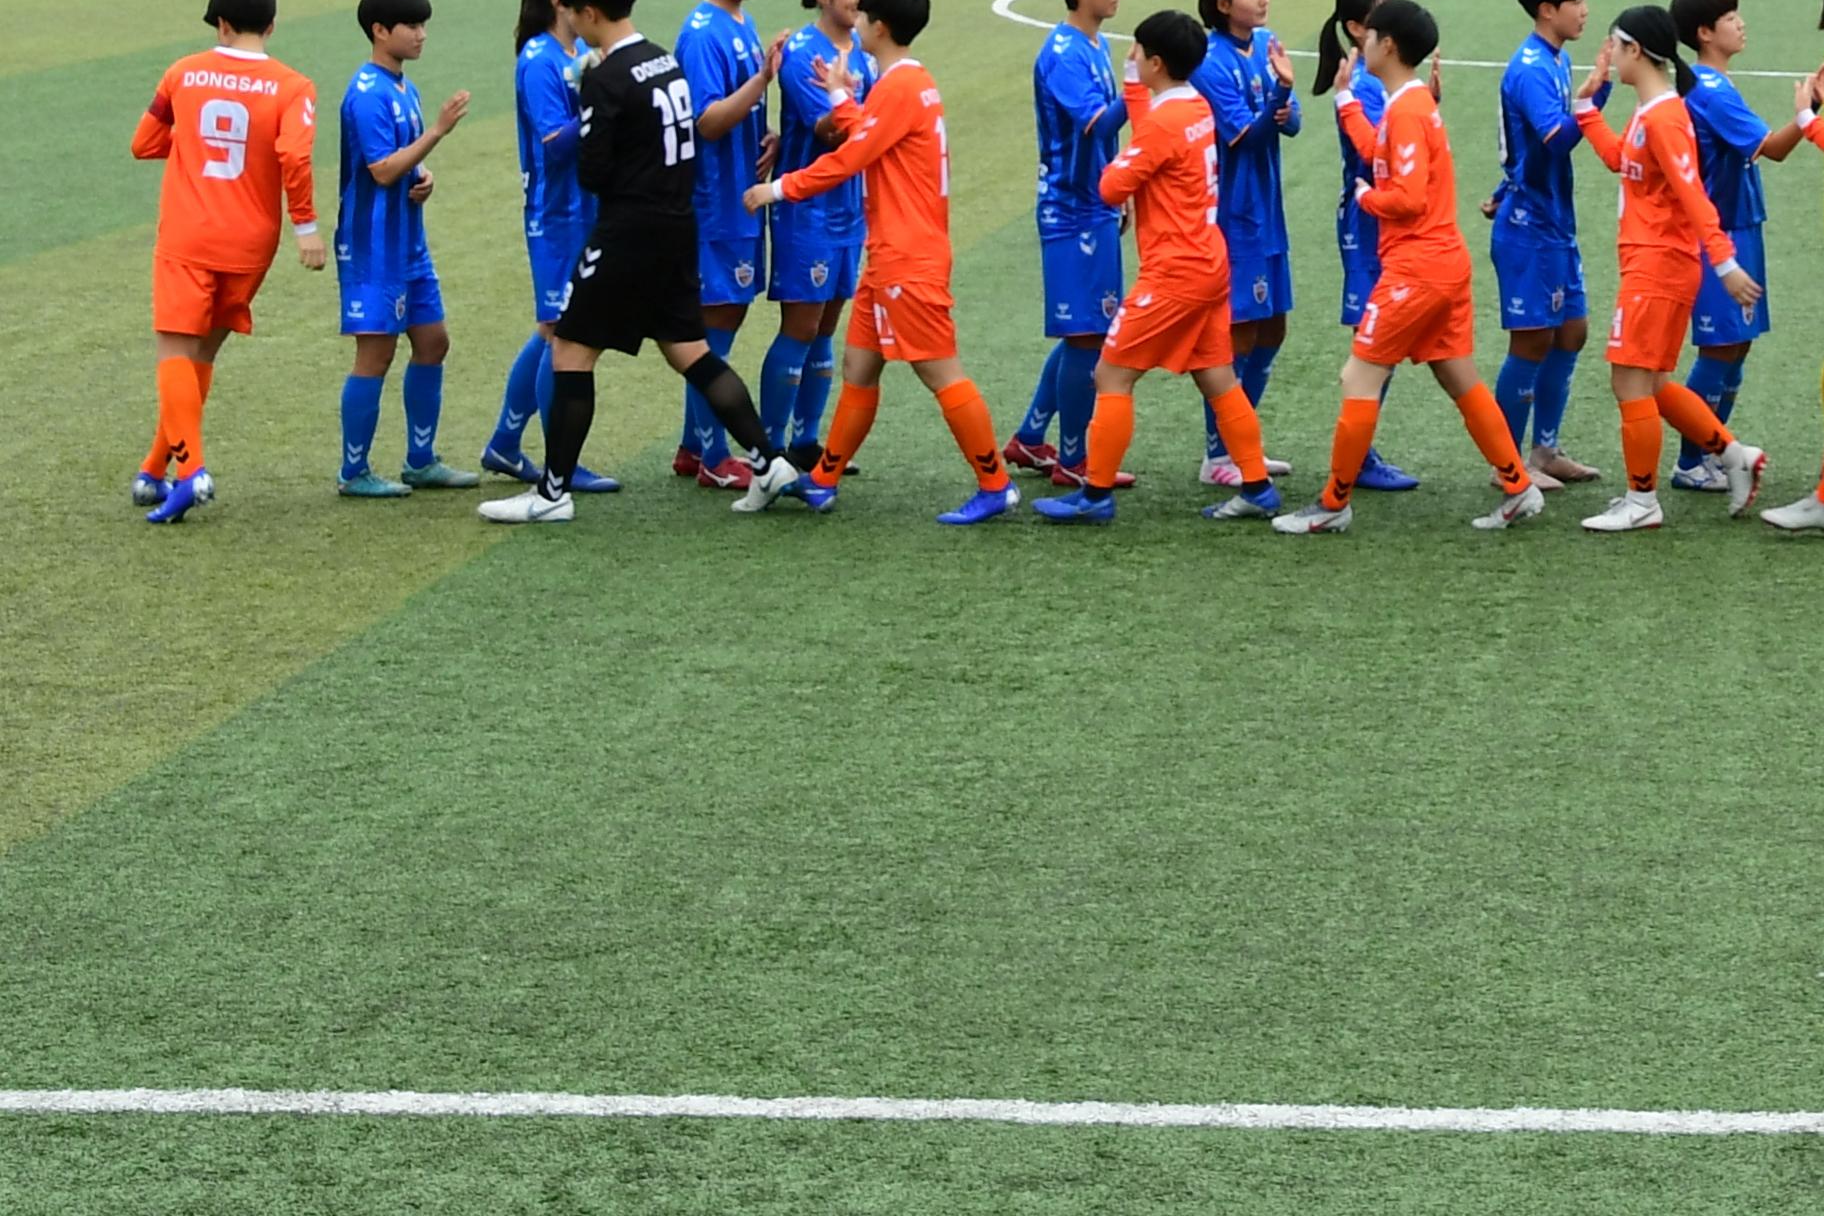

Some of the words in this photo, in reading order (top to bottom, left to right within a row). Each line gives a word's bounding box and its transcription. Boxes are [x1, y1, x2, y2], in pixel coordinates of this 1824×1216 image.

[183, 70, 279, 96] DONGSAN
[652, 78, 696, 167] 19
[200, 98, 250, 181] 9
